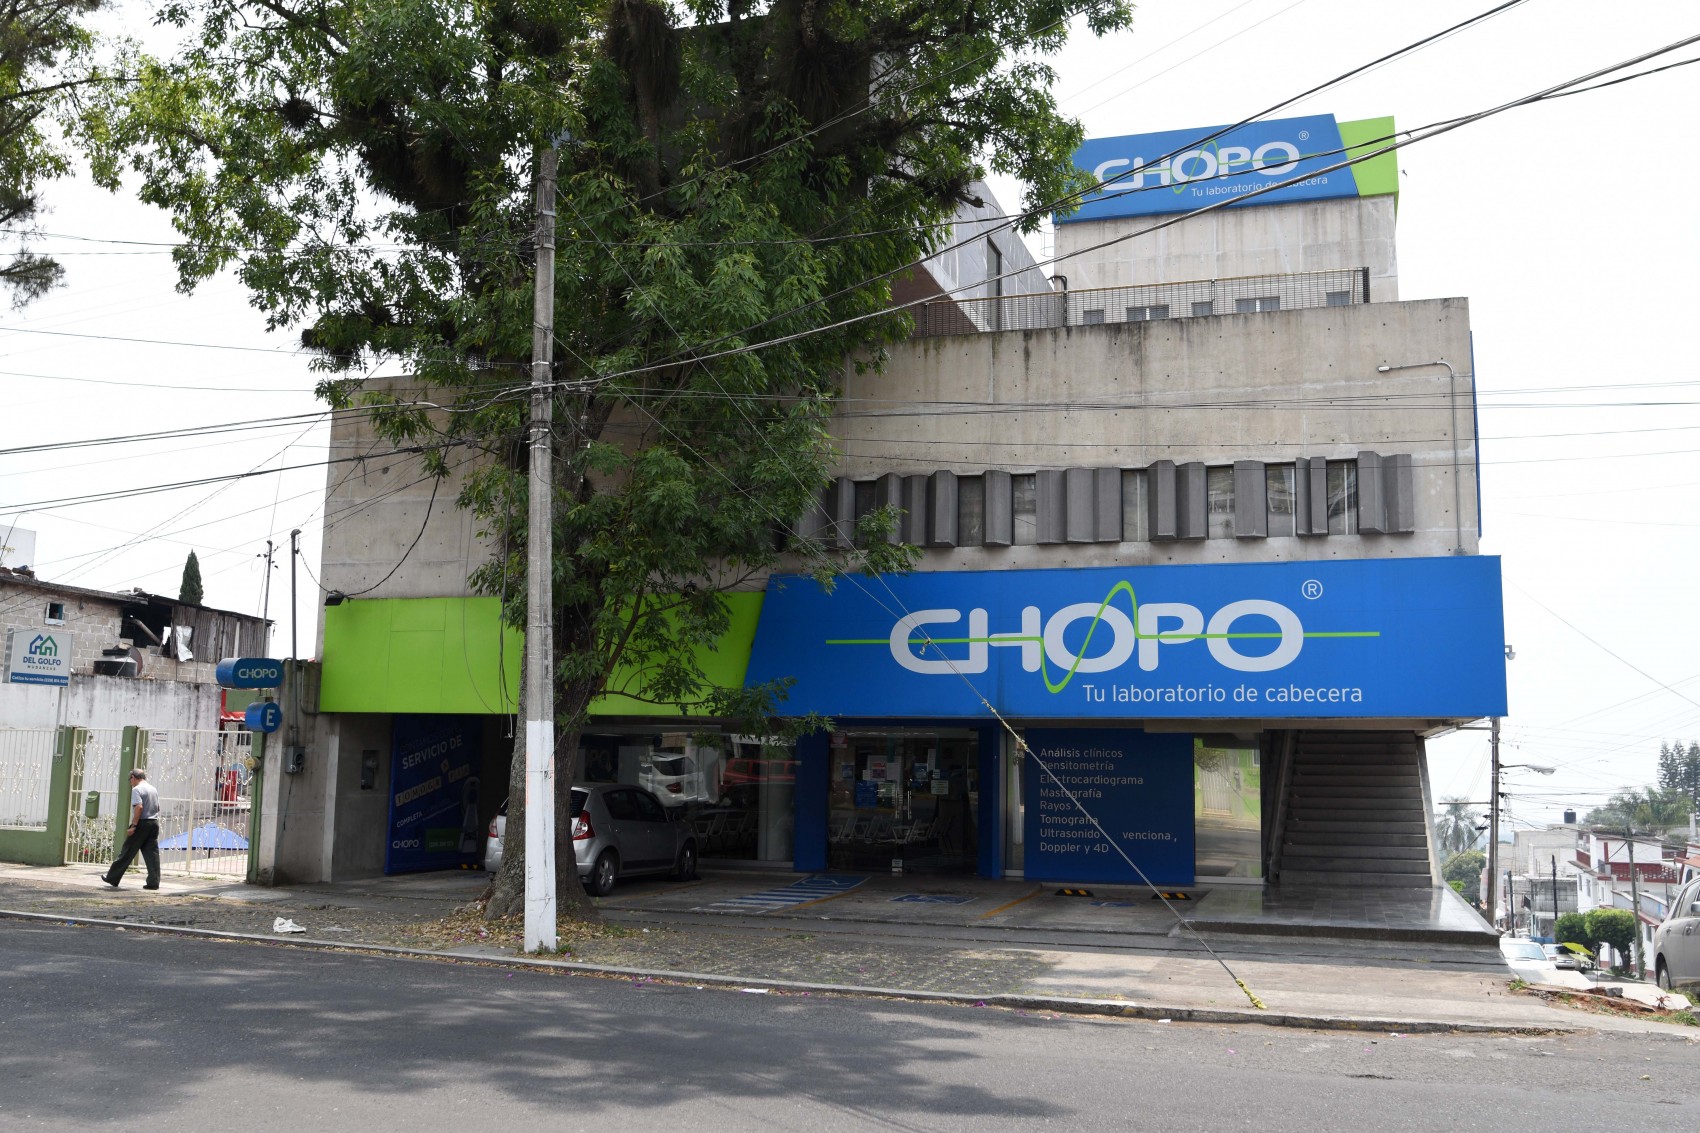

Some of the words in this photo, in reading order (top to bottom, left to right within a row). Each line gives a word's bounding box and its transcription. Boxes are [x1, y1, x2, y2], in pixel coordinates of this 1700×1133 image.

[1093, 141, 1301, 191] CHOPO
[1192, 187, 1203, 197] Tu
[1206, 181, 1263, 196] laboratorio
[889, 598, 1304, 675] CHOPO
[23, 656, 36, 664] DEL
[38, 658, 62, 666] GOLFO
[238, 668, 278, 679] CHOPO
[1082, 684, 1106, 703] Tu
[1111, 682, 1226, 703] laboratorio
[1232, 682, 1259, 703] de
[1264, 682, 1363, 703] cabecera
[266, 709, 276, 727] E
[402, 741, 447, 769] SERVICIO
[449, 734, 463, 750] DE
[1040, 747, 1080, 759] Análisis
[1083, 747, 1124, 759] clínicos
[1040, 761, 1115, 771] Densitometría
[1040, 774, 1144, 787] Electrocardiograma
[1040, 788, 1103, 800] Mastografía
[1040, 801, 1072, 812] Rayos
[396, 811, 423, 828] COMPLETA
[1040, 828, 1101, 839] Ultrasonido
[392, 838, 420, 849] CHOPO
[1040, 842, 1081, 854] Doppler
[1084, 845, 1090, 855] y
[1093, 843, 1110, 853] 4D
